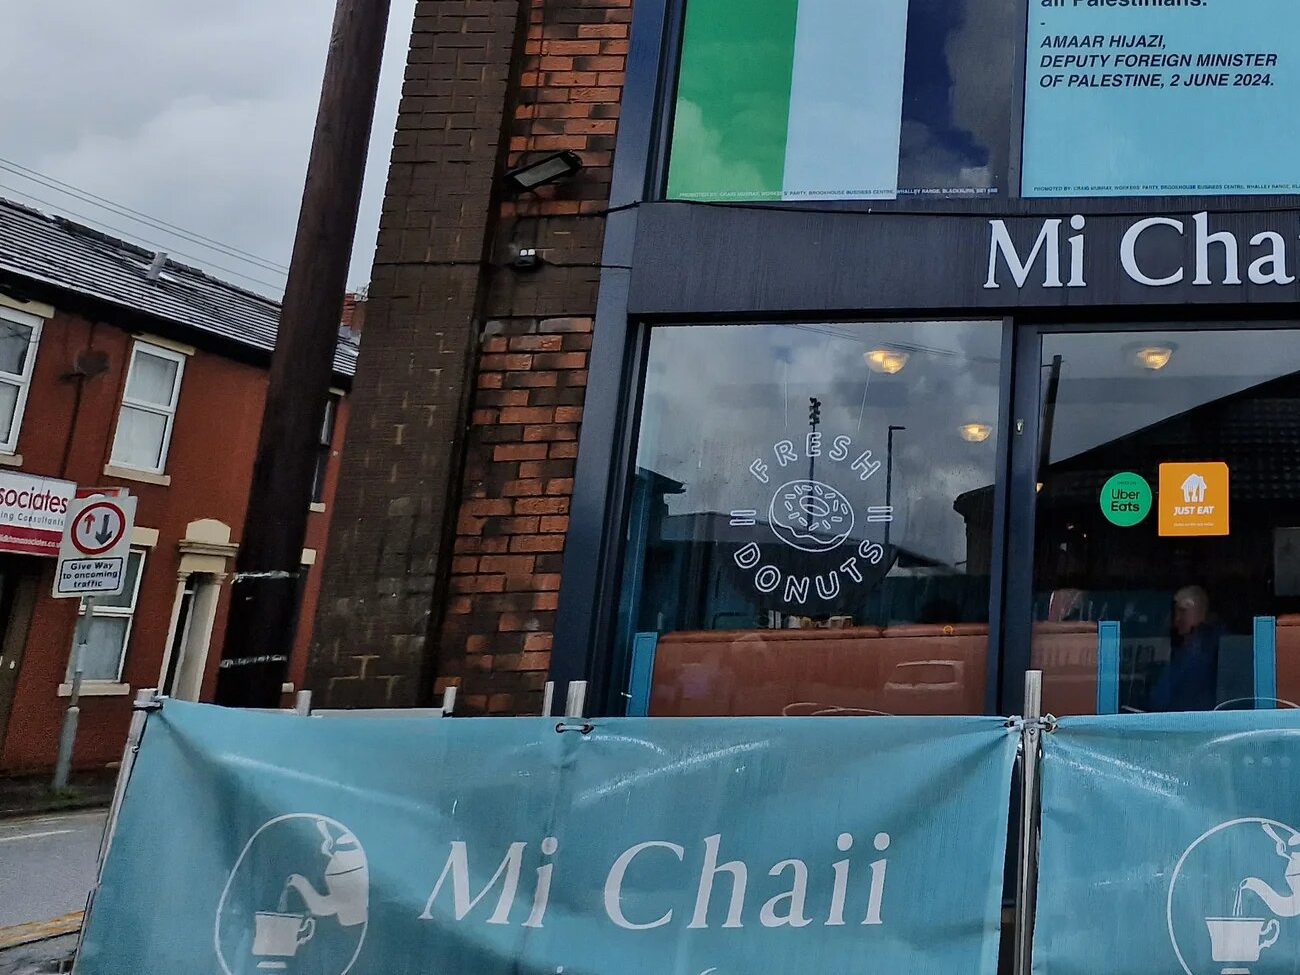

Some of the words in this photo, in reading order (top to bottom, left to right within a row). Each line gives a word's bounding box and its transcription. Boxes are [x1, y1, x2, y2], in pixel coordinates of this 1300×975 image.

[1040, 36, 1104, 48] AMAAR
[1109, 35, 1165, 49] HIJAZI,
[1040, 55, 1110, 67] DEPUTY
[1115, 54, 1192, 67] FOREIGN
[1197, 54, 1277, 66] MINISTER
[1040, 75, 1064, 87] OF
[1068, 74, 1164, 89] PALESTINE,
[1170, 74, 1180, 86] 2
[1184, 74, 1229, 86] JUNE
[1233, 74, 1273, 86] 2024.
[983, 214, 1086, 288] Mi
[749, 432, 881, 484] FRESH
[1111, 489, 1140, 500] Uber
[1111, 500, 1140, 512] Eats
[1173, 506, 1196, 516] JUST
[1197, 505, 1215, 515] EAT
[70, 563, 91, 571] Give
[94, 562, 113, 570] Way
[734, 540, 883, 604] DONUTS
[74, 571, 118, 579] oncoming
[418, 836, 559, 928] Mi
[603, 832, 890, 930] Chaii
